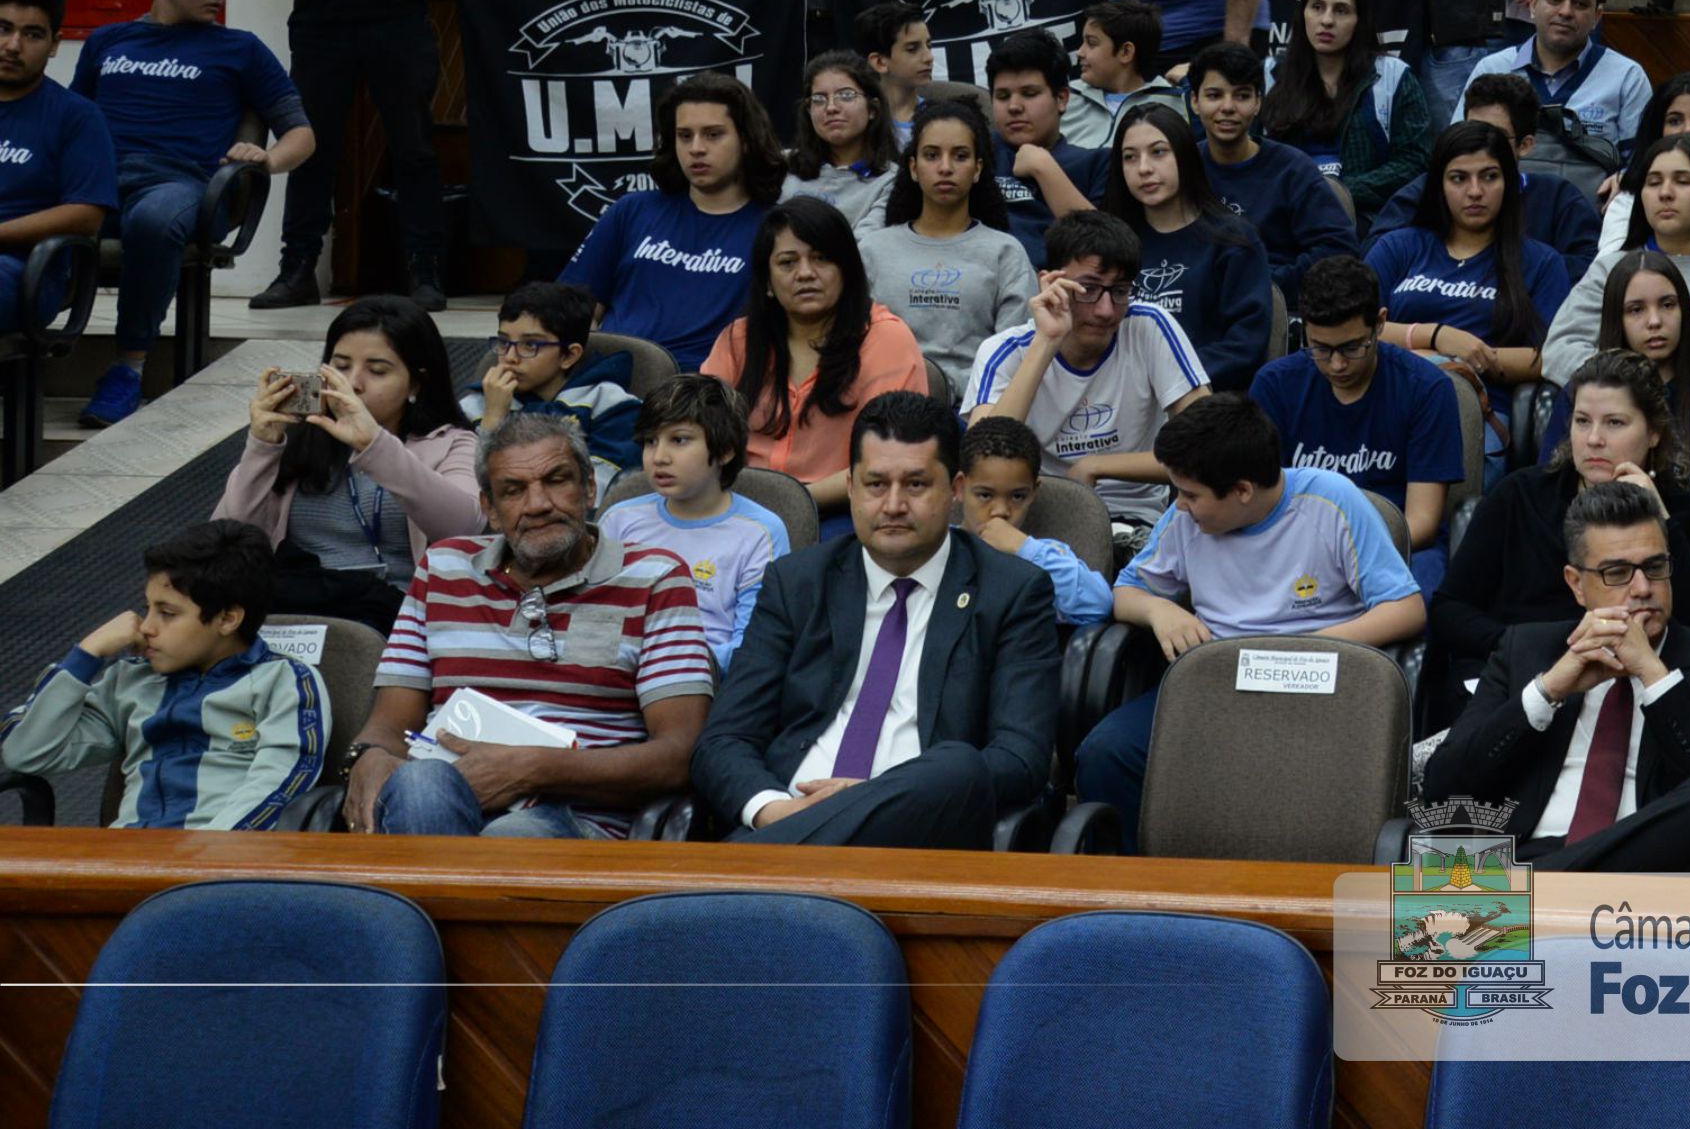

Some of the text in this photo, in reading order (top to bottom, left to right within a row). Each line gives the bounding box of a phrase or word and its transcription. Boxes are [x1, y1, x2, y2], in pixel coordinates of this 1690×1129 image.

[537, 8, 578, 34] União
[717, 11, 733, 27] de
[626, 173, 660, 192] 201
[633, 235, 746, 275] Interativa
[909, 294, 960, 305] Interativa
[1056, 435, 1119, 453] Interativa
[1292, 441, 1397, 474] Interatva
[1244, 668, 1331, 683] RESERVADO
